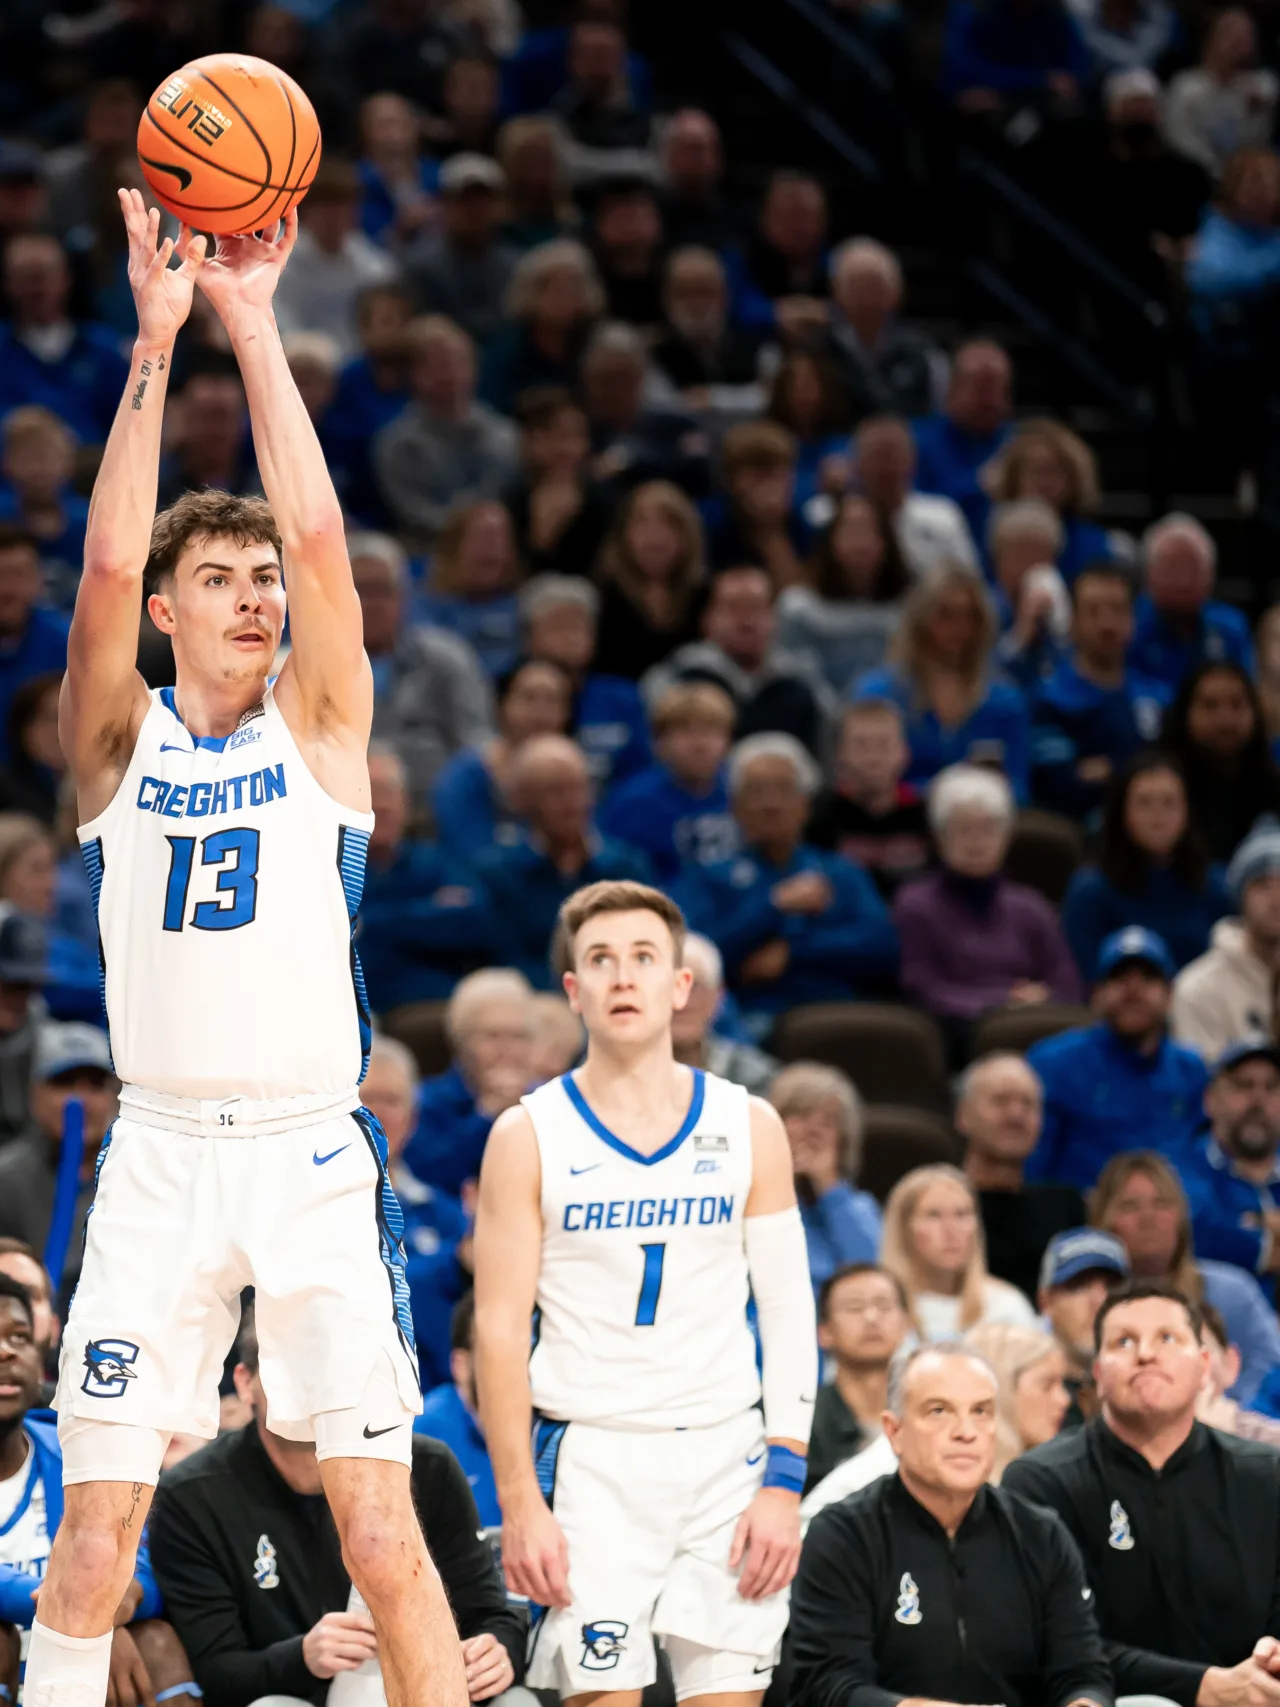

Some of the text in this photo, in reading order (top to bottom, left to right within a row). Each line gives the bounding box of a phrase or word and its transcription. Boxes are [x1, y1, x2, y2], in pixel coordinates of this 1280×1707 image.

[156, 83, 225, 147] ELITE
[230, 731, 263, 748] EAST
[231, 726, 254, 741] BIG
[136, 763, 288, 819] CREGHTON
[162, 827, 261, 932] 13
[562, 1195, 735, 1232] CREIGHTON
[634, 1243, 667, 1326] 1
